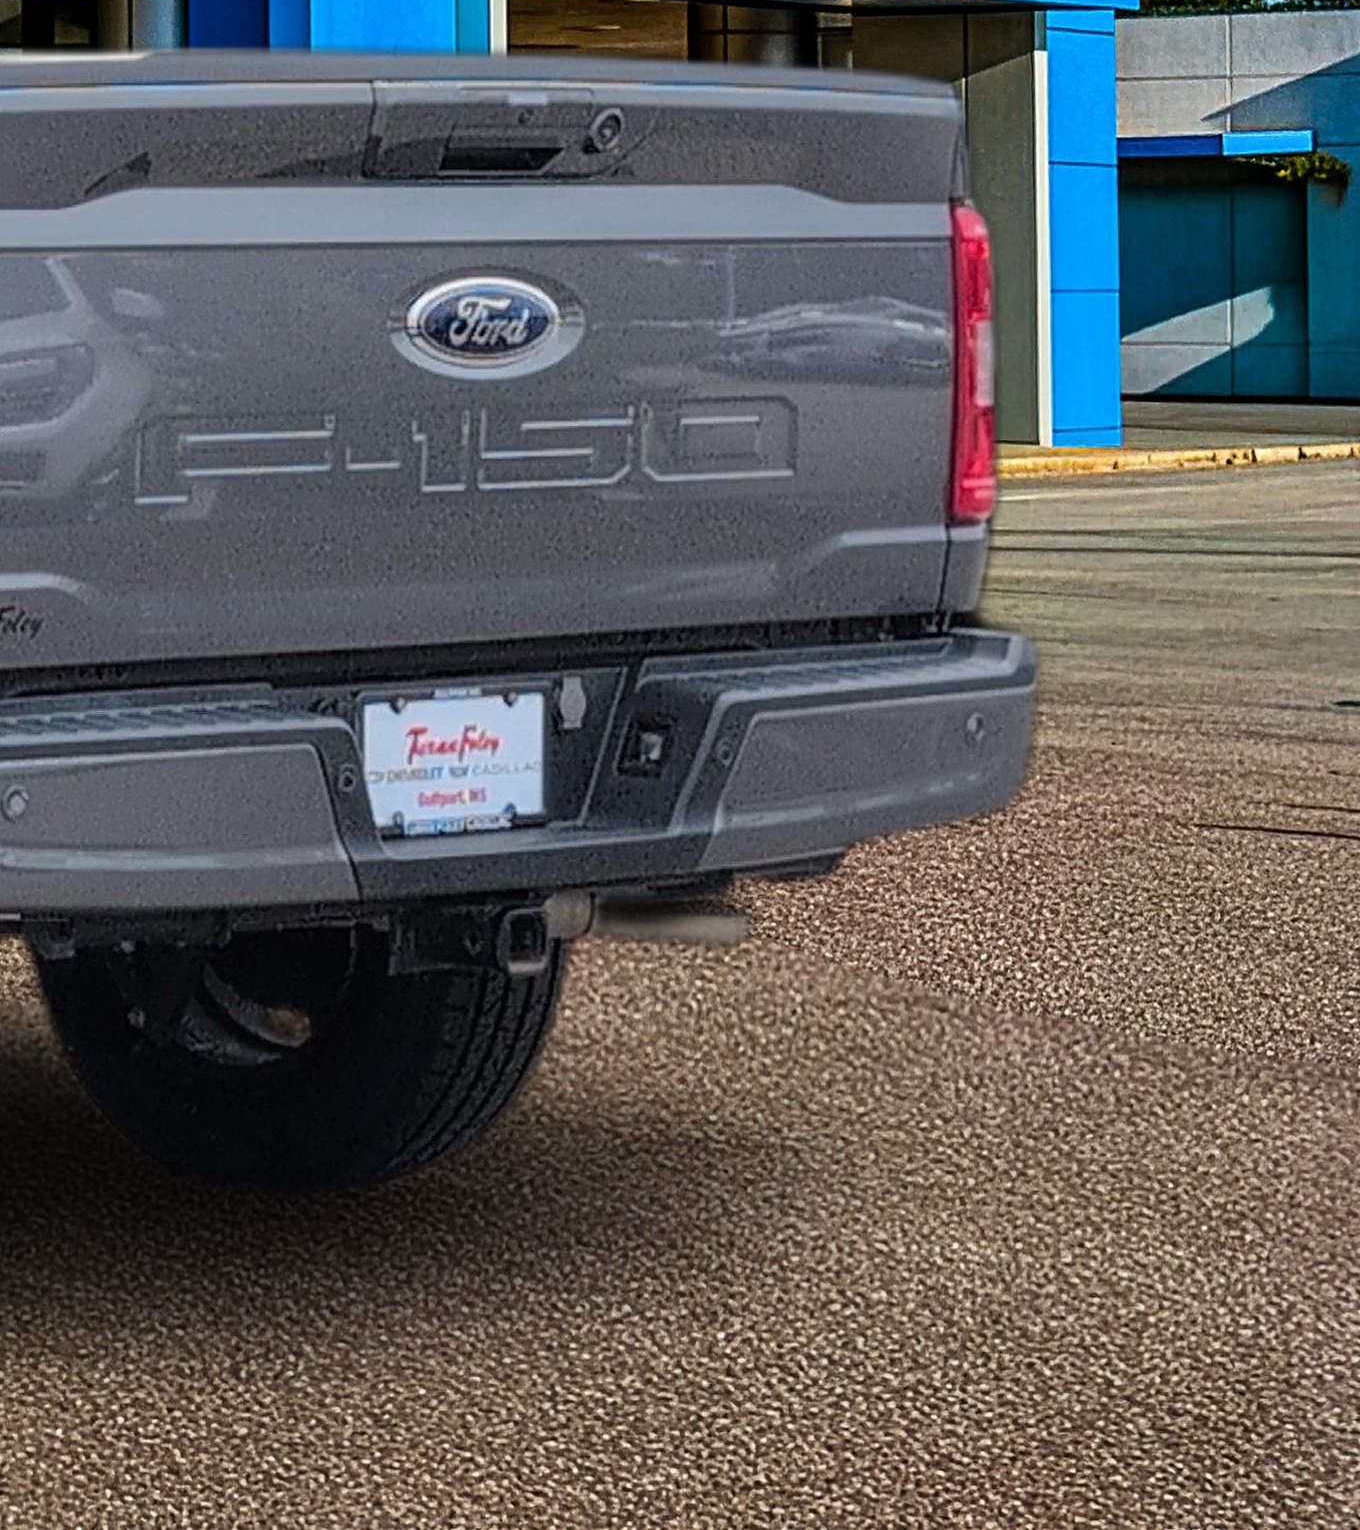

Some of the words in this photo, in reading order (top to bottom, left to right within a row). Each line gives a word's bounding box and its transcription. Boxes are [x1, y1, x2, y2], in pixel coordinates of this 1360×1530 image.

[449, 296, 530, 346] Ford
[135, 395, 799, 504] F-150
[406, 726, 457, 765] Turan
[457, 724, 501, 763] Foley
